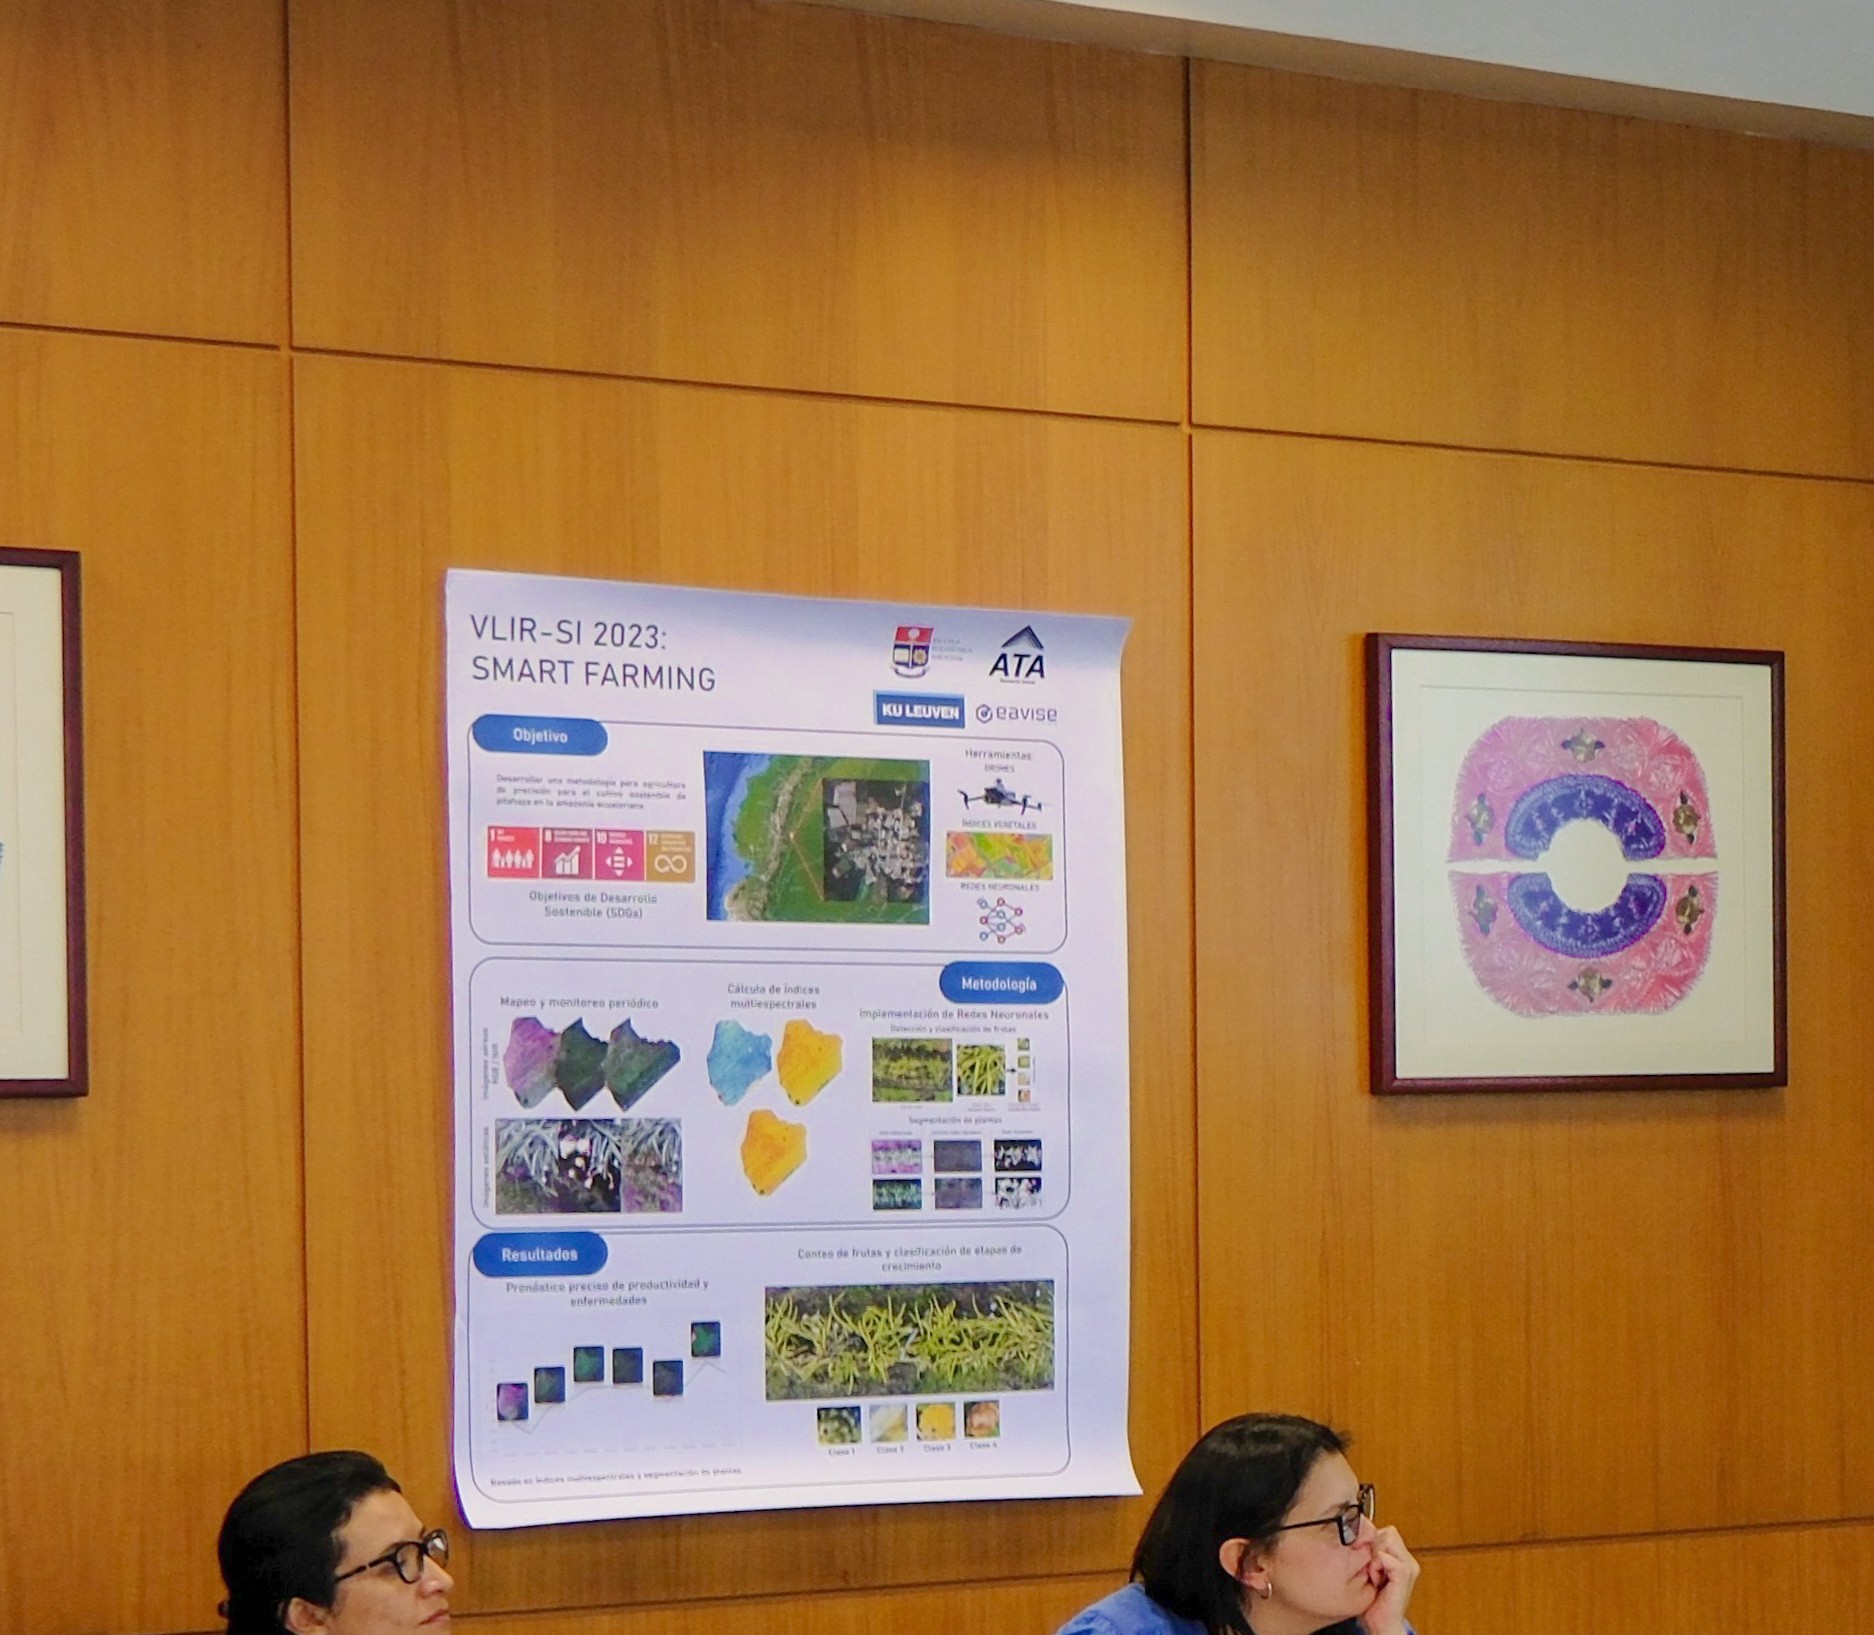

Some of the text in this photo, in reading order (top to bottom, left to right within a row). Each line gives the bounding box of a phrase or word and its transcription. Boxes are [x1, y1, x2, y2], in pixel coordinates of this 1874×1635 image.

[470, 614, 667, 650] VLIR-SI 2023:
[471, 655, 716, 692] SMART FARMING
[988, 652, 1046, 679] ATA
[882, 703, 960, 720] KU LEUVEN
[996, 706, 1058, 722] eavise
[513, 726, 568, 745] Objetivo
[529, 890, 581, 905] Objetivos
[584, 891, 597, 902] de
[544, 906, 603, 918] Sostenible
[961, 975, 1038, 994] Metodología
[500, 996, 536, 1011] Mapeo
[501, 1246, 578, 1263] Resultados
